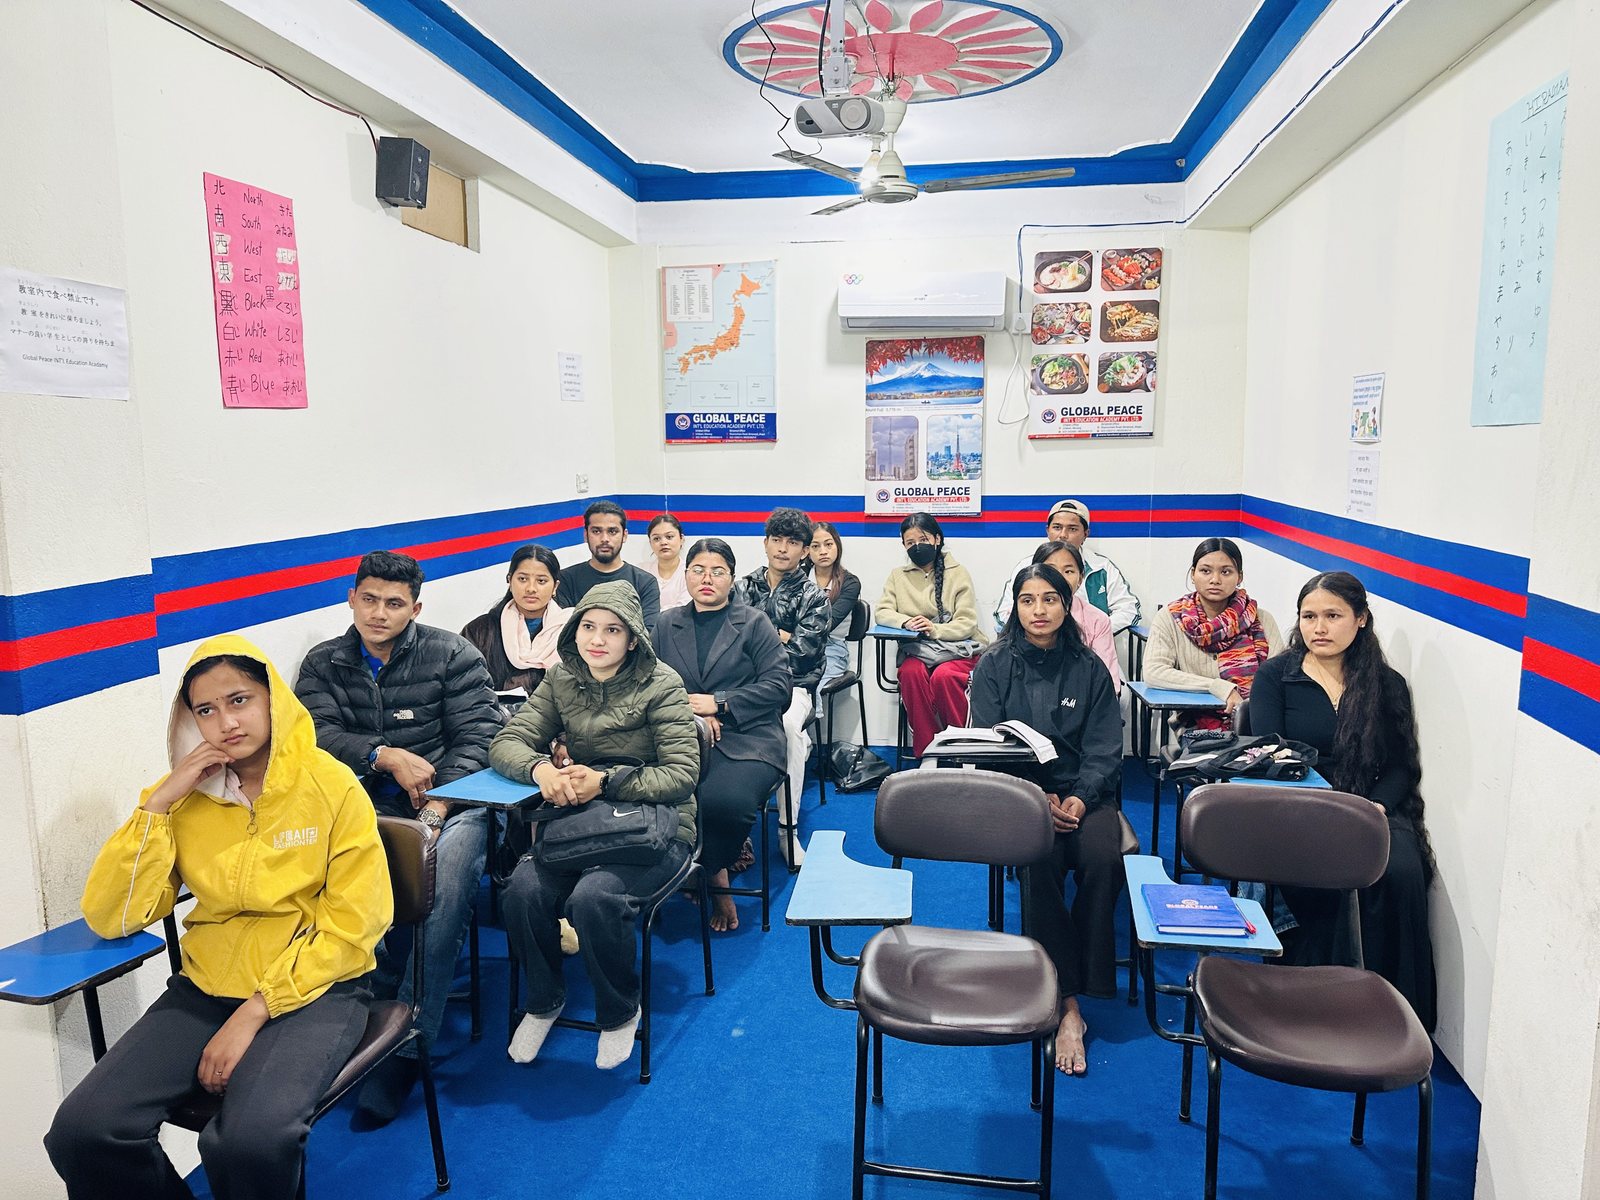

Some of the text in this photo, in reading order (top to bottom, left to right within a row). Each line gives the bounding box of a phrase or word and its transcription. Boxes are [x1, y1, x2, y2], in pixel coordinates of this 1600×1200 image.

[214, 179, 226, 195] 北
[243, 188, 263, 207] North
[241, 213, 261, 230] South
[243, 238, 263, 256] West
[244, 267, 263, 284] East
[244, 292, 267, 311] Black
[244, 320, 267, 339] White
[66, 358, 88, 366] Education
[249, 347, 262, 363] Red
[693, 414, 766, 423] GLOBAL PEACE
[1060, 405, 1143, 416] GLOBAL PEACE
[894, 486, 970, 496] GLOBAL PEACE
